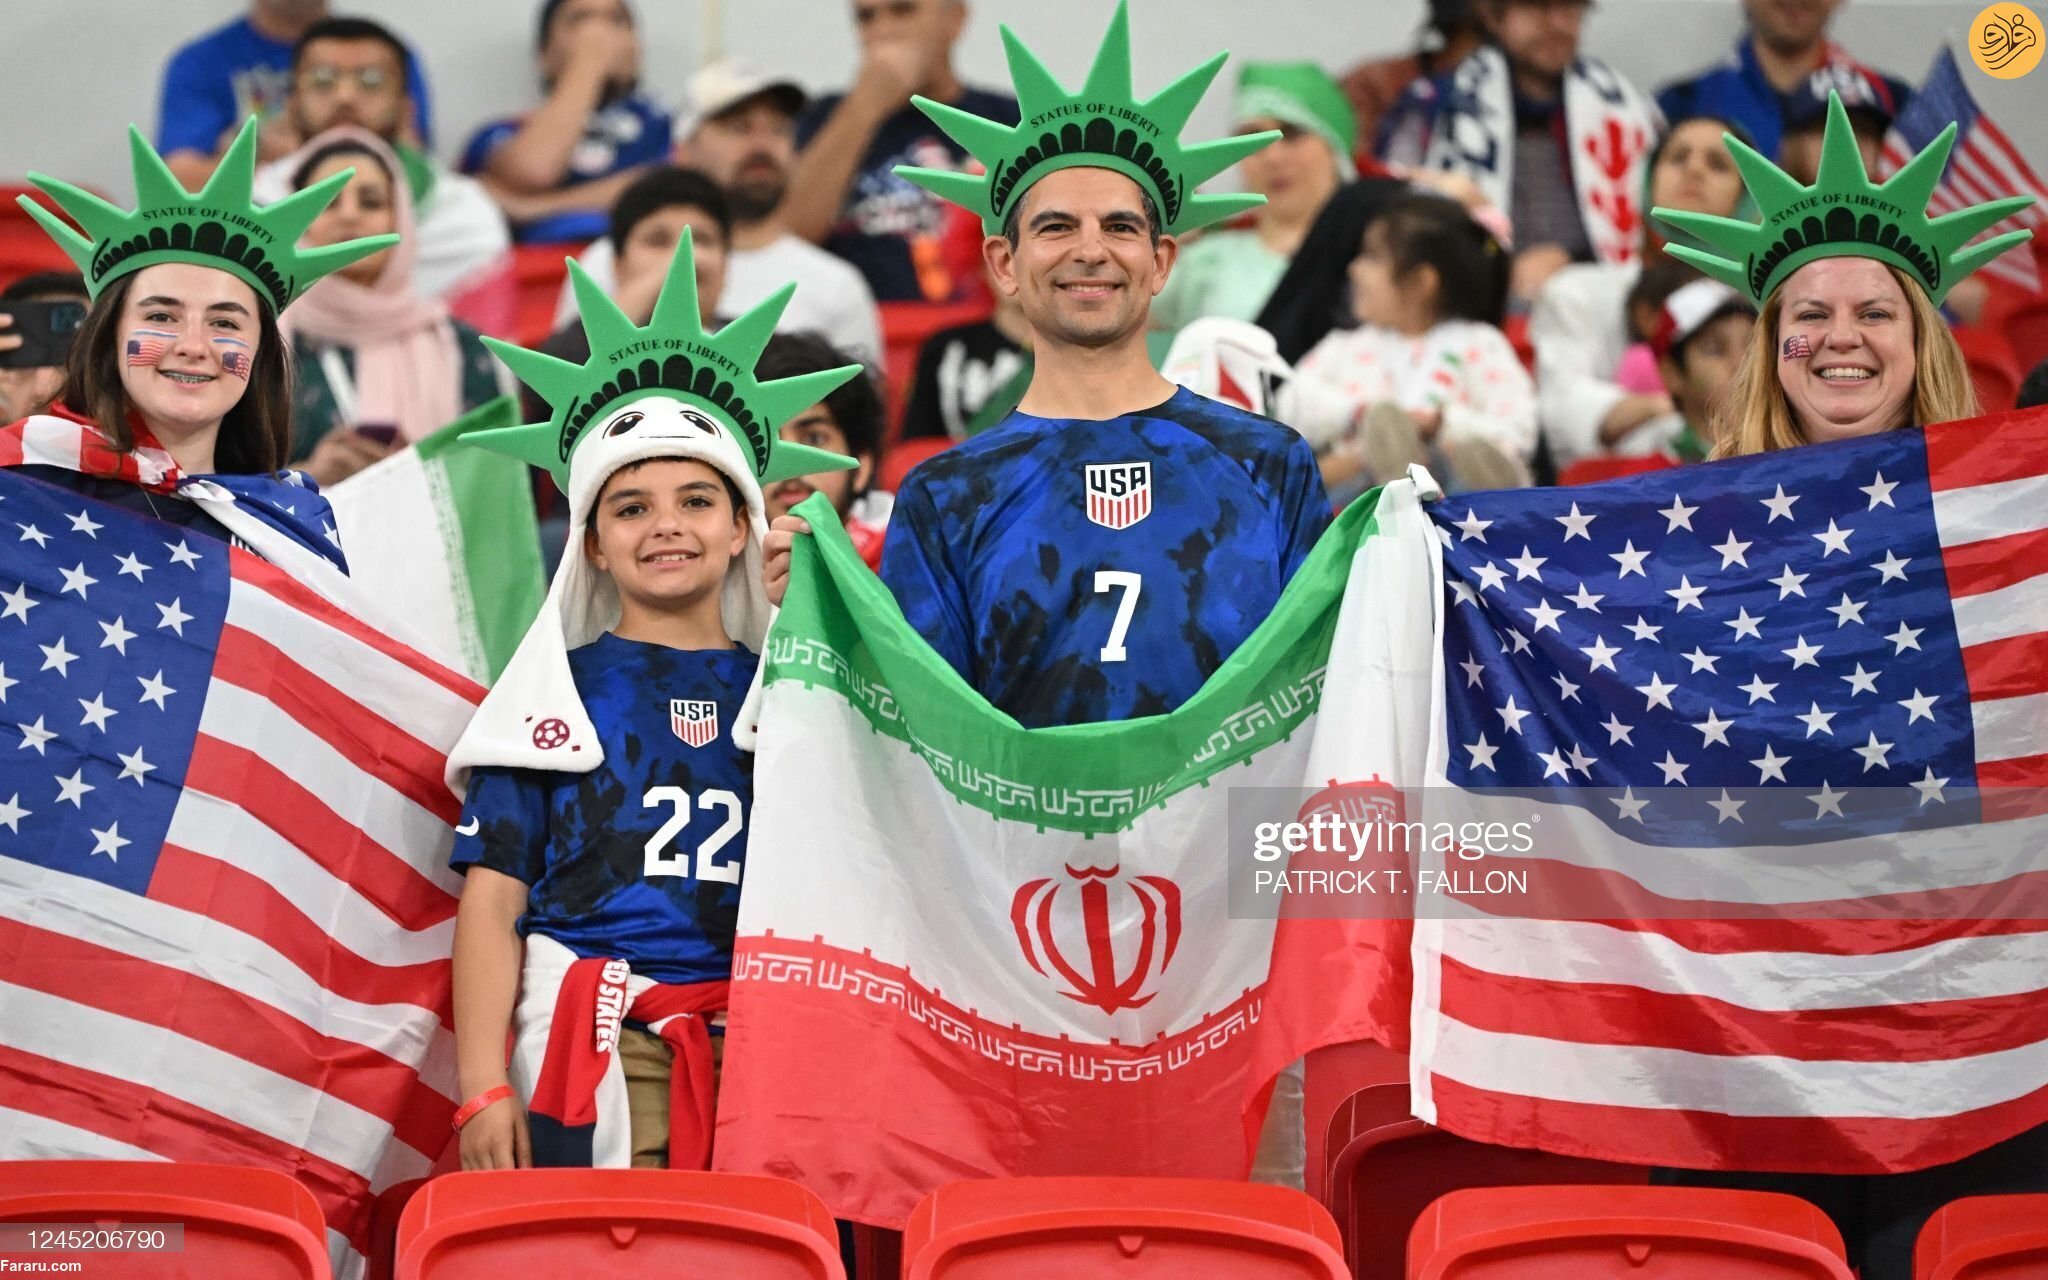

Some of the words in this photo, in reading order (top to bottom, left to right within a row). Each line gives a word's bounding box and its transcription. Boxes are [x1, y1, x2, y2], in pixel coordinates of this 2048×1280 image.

[1030, 103, 1083, 129] STATUE
[1086, 102, 1107, 114] OF
[1108, 105, 1164, 138] LIBERTY
[142, 207, 197, 221] STATUE
[200, 207, 221, 218] OF
[222, 211, 279, 245] LIBERTY
[1770, 196, 1820, 226] STATUE
[1822, 193, 1843, 204] OF
[1844, 193, 1907, 219] LIBERTY
[608, 338, 661, 365] STATUE
[664, 338, 685, 350] OF
[686, 341, 744, 377] LIBERTY
[1089, 465, 1147, 497] USA
[1094, 570, 1142, 662] 7
[673, 701, 715, 722] USA
[642, 785, 743, 886] 22
[602, 959, 630, 984] ED
[596, 983, 625, 1053] STATES
